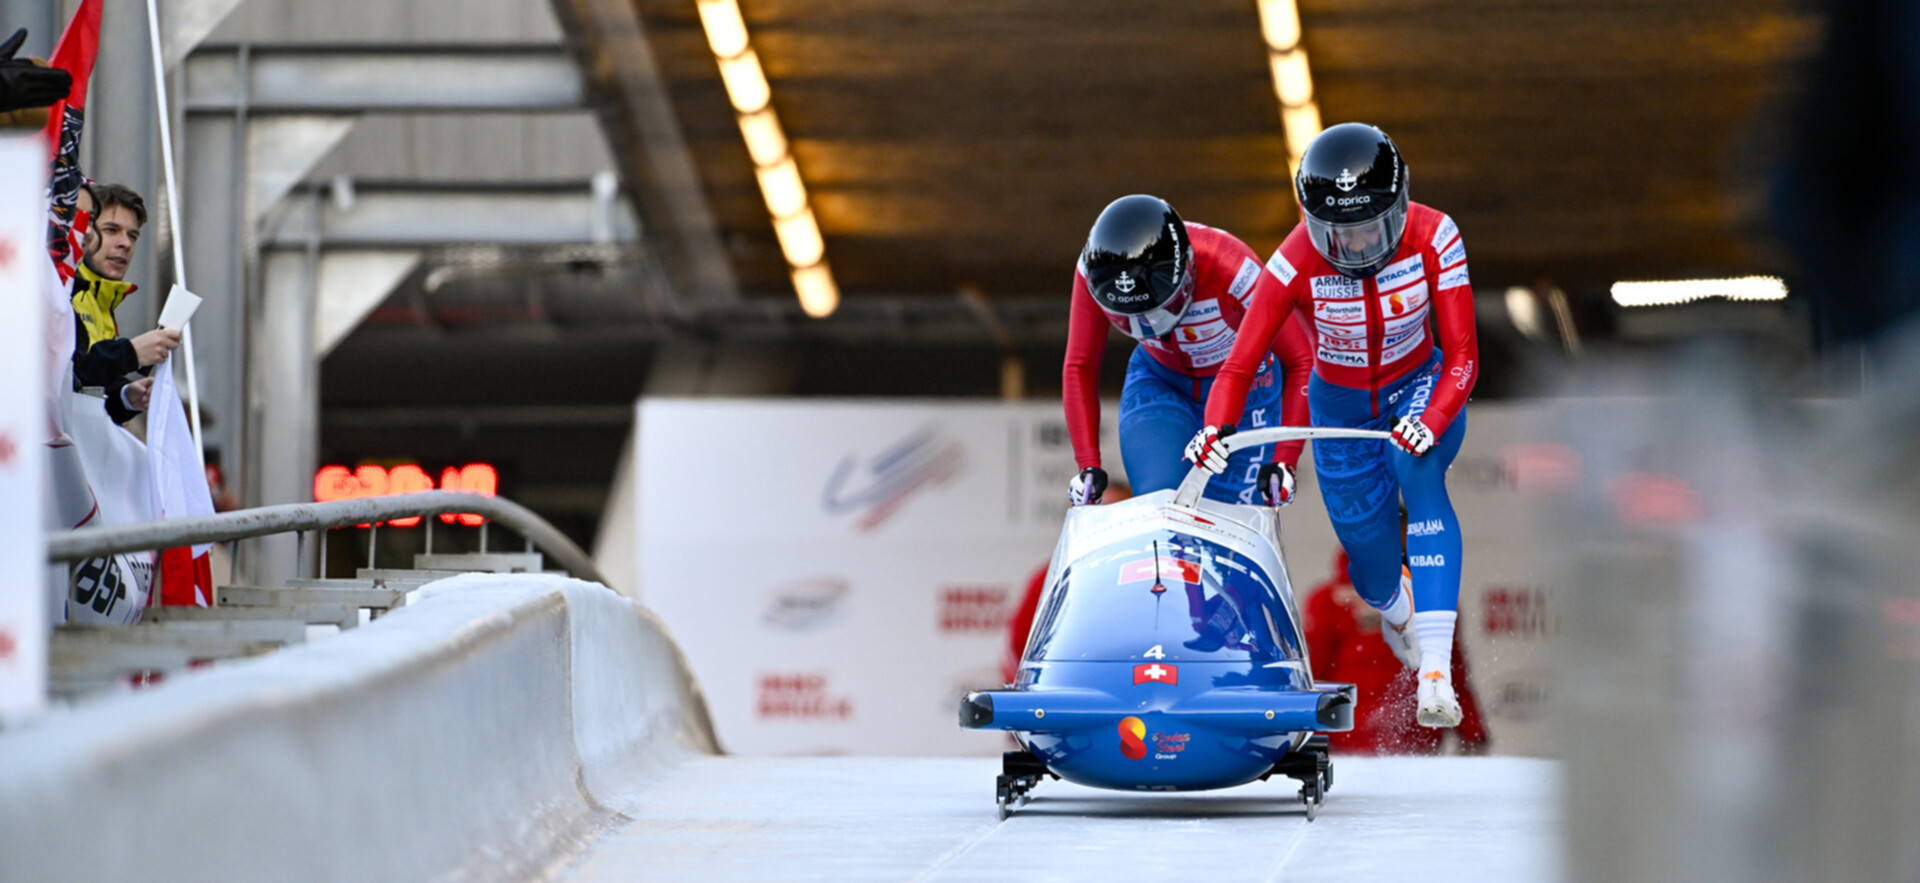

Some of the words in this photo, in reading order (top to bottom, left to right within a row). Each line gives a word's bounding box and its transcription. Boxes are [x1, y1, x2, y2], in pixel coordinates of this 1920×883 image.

[1377, 262, 1422, 284] STADLER
[1316, 286, 1360, 298] SUISSE
[1409, 554, 1446, 567] KIBAG
[1143, 644, 1166, 660] 4
[1156, 732, 1190, 743] Swiss
[1156, 741, 1185, 753] Steel
